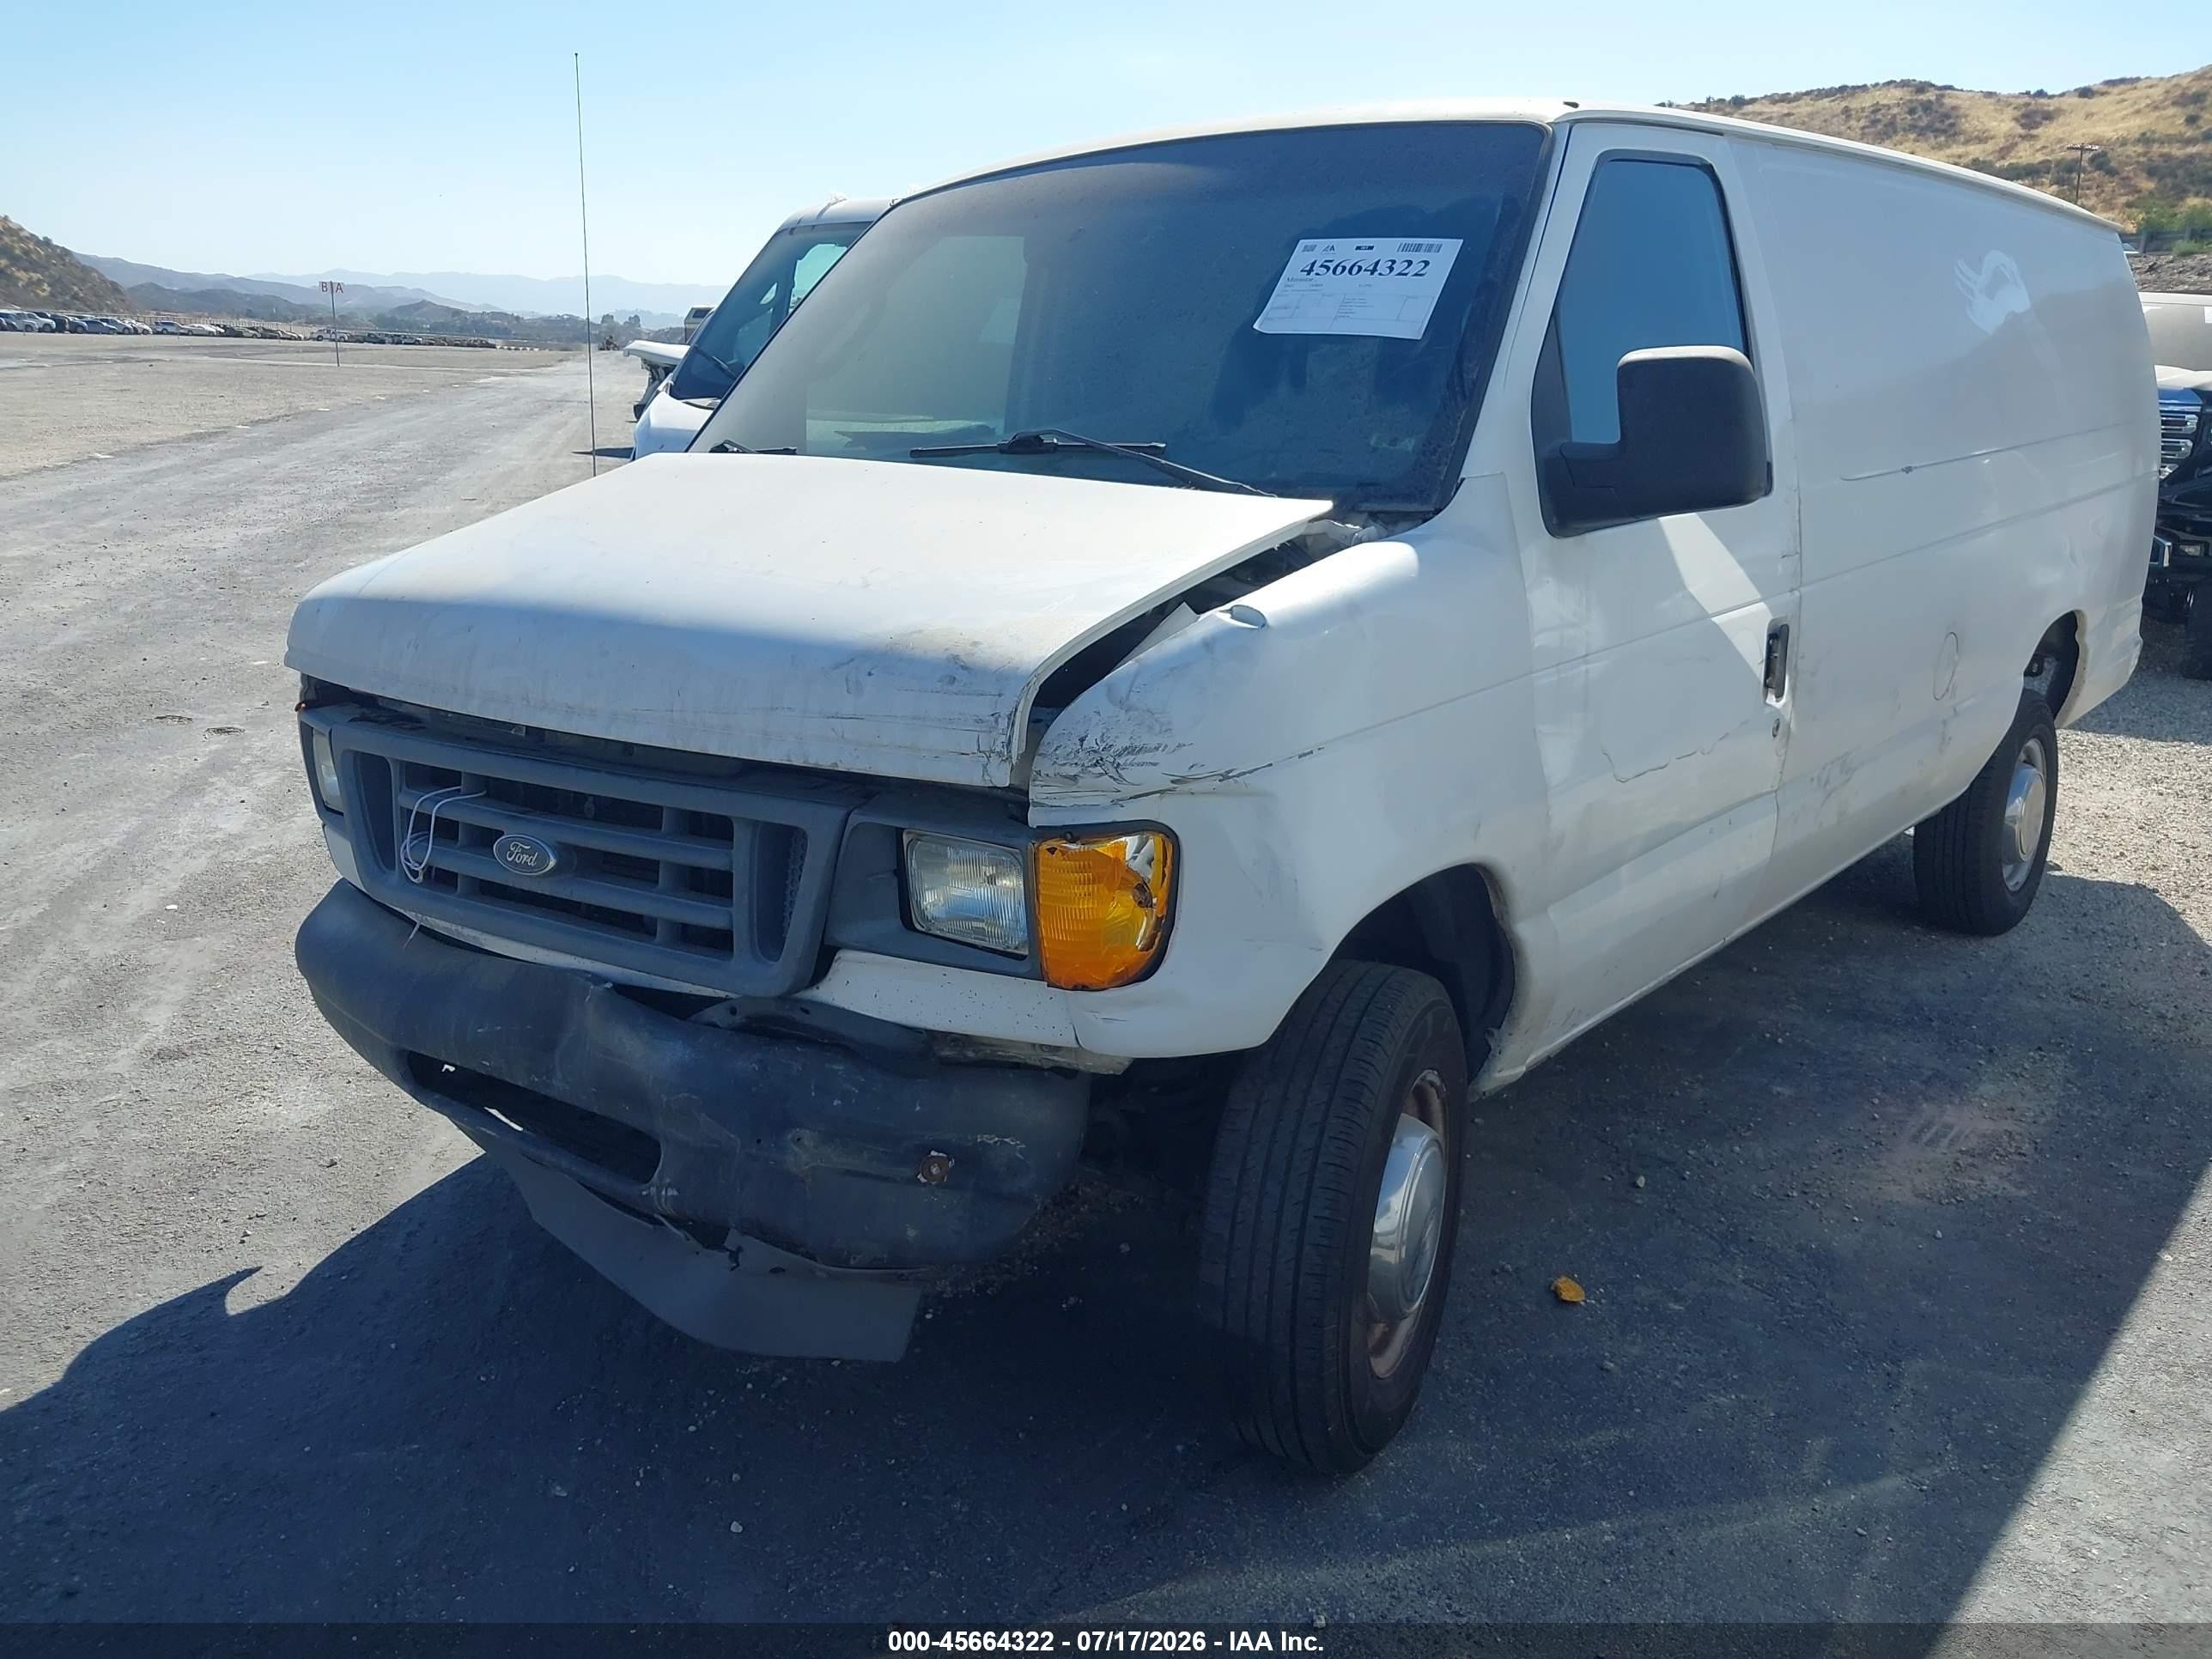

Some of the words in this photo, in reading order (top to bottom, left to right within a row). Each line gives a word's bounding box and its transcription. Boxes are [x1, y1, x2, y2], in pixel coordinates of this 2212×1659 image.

[1299, 258, 1431, 276] 45664322
[321, 281, 328, 293] B
[335, 282, 344, 294] A
[506, 841, 538, 866] Ford
